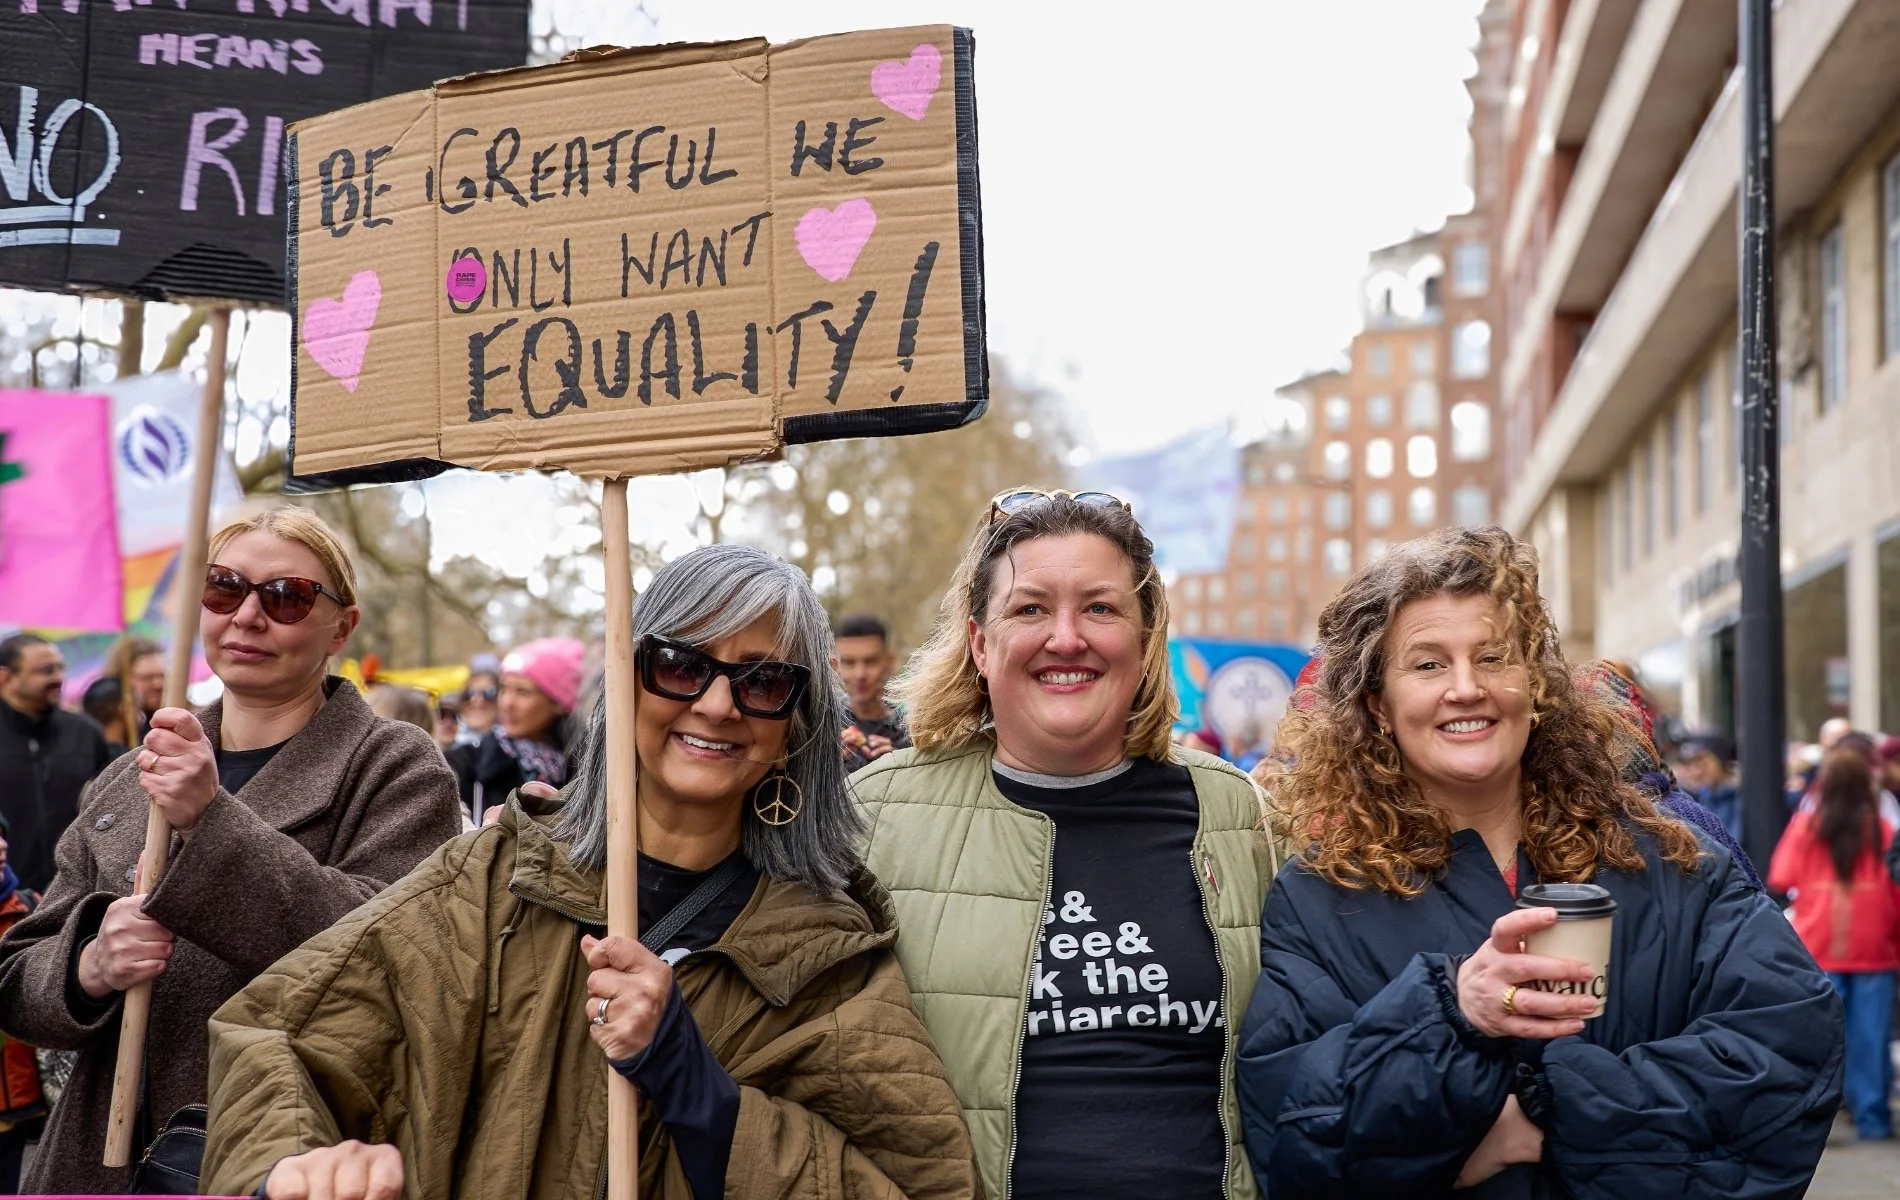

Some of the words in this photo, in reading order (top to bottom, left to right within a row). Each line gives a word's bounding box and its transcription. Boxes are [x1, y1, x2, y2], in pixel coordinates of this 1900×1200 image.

[0, 86, 121, 206] NO
[180, 107, 288, 216] RI
[319, 144, 394, 238] BE
[438, 126, 738, 215] GREATFUL
[790, 117, 885, 177] WE
[446, 237, 571, 314] ONLY
[621, 211, 773, 297] WANT
[1082, 958, 1169, 995] the
